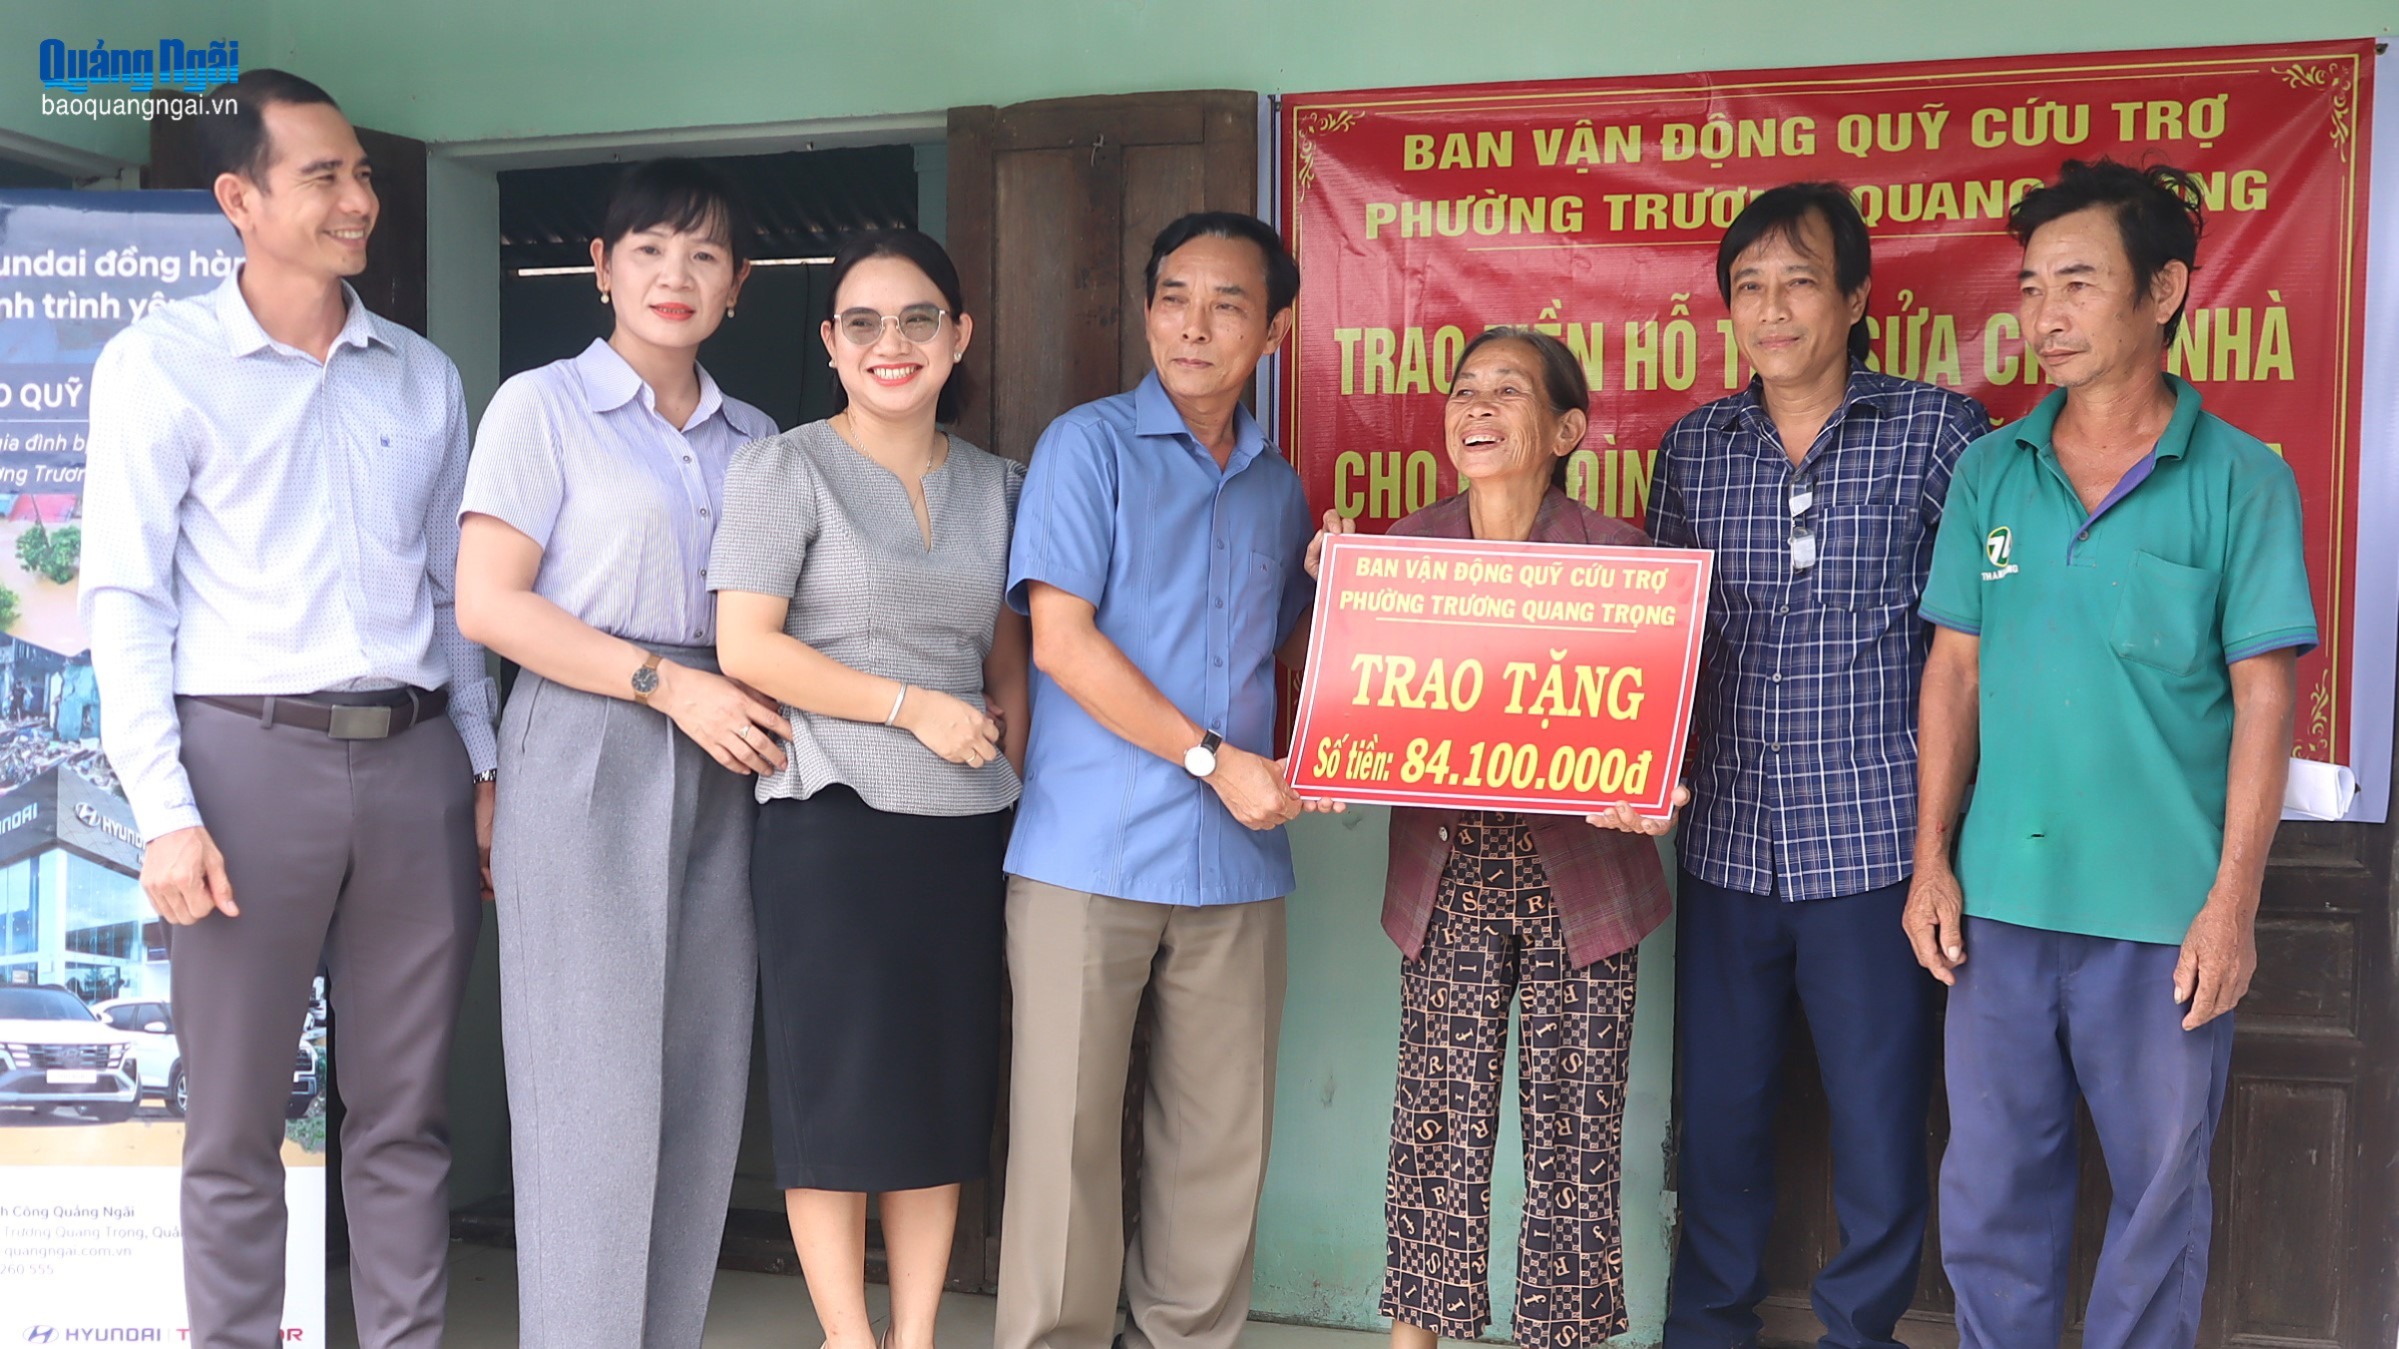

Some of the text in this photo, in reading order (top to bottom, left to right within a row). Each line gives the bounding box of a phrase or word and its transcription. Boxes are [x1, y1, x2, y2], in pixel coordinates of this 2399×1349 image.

[1403, 93, 2229, 174] BAN VẬN ĐỘNG QUỸ CỨU TRỢ
[1366, 187, 1584, 240] PHƯỜNG
[1603, 185, 1766, 231] TRƯƠ
[94, 246, 181, 283] đồng
[42, 290, 121, 319] trình
[1334, 325, 1466, 395] TRAO
[1625, 292, 1697, 391] HỖ
[2167, 290, 2295, 382] NHÀ
[20, 377, 84, 411] QUỸ
[0, 433, 20, 452] ia
[25, 433, 68, 452] đình
[1335, 450, 1438, 519] CHO
[1355, 555, 1670, 593] BAN VẬN ĐỘNG QUỸ CỨU TRỢ
[1339, 588, 1677, 629] PHƯỜNG TRƯƠNG QUANG TRỌNG
[1350, 648, 1647, 730] TRAO TẶNG
[1312, 733, 1655, 795] Số tiền: 84.100.000đ
[0, 802, 38, 834] NDAI
[12, 1205, 49, 1220] Công
[53, 1204, 99, 1220] Quảng
[103, 1205, 135, 1220] Ngãi
[55, 1226, 100, 1240] Quang
[152, 1226, 183, 1239] Quả
[29, 1263, 55, 1275] 555
[65, 1328, 161, 1342] HYUNDAI
